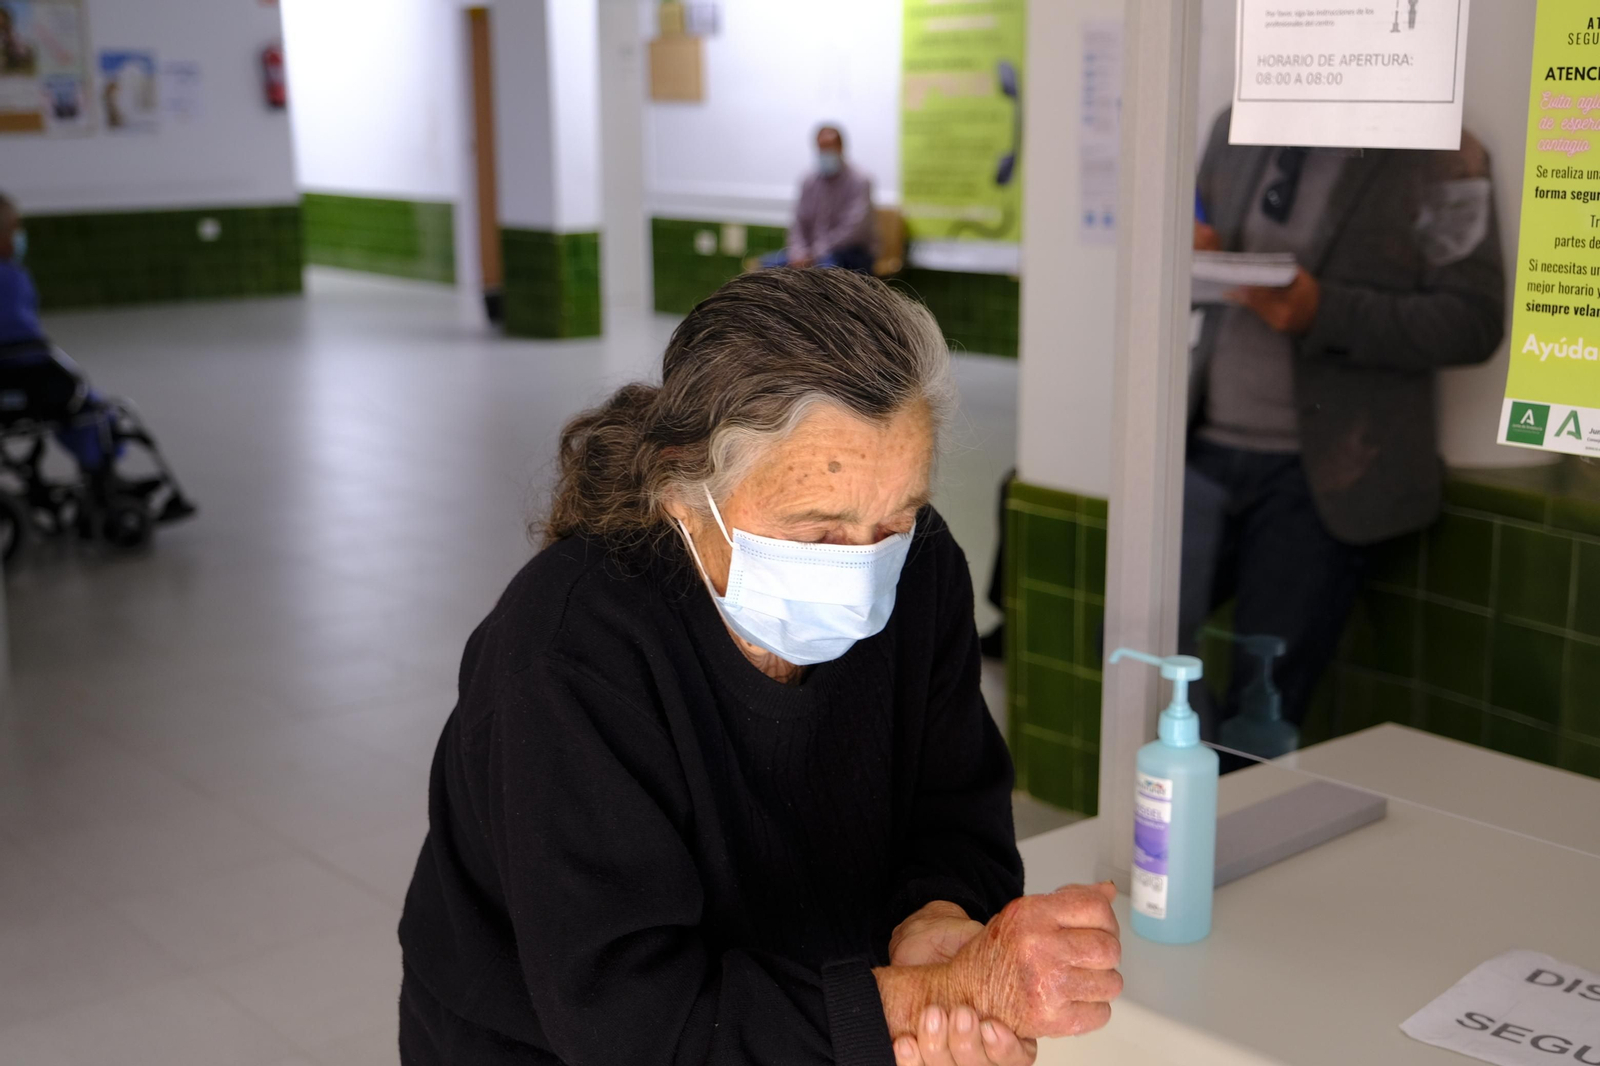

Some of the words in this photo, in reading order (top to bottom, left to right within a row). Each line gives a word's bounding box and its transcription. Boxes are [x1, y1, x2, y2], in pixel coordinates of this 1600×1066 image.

[1568, 32, 1600, 45] SEGU
[1257, 54, 1314, 67] HORARIO
[1317, 54, 1335, 66] DE
[1339, 53, 1414, 66] APERTURA:
[1256, 72, 1290, 85] 08:00
[1294, 72, 1303, 85] A
[1306, 72, 1343, 85] 08:00
[1539, 116, 1554, 130] de
[1537, 138, 1590, 157] contagio
[1536, 164, 1548, 178] Se
[1551, 166, 1584, 179] realiza
[1535, 186, 1567, 199] forma
[1554, 236, 1586, 249] partes
[1528, 258, 1538, 272] Si
[1540, 262, 1587, 275] necesitas
[1527, 280, 1555, 295] mejor
[1558, 281, 1594, 296] horario
[1526, 299, 1570, 316] siempre
